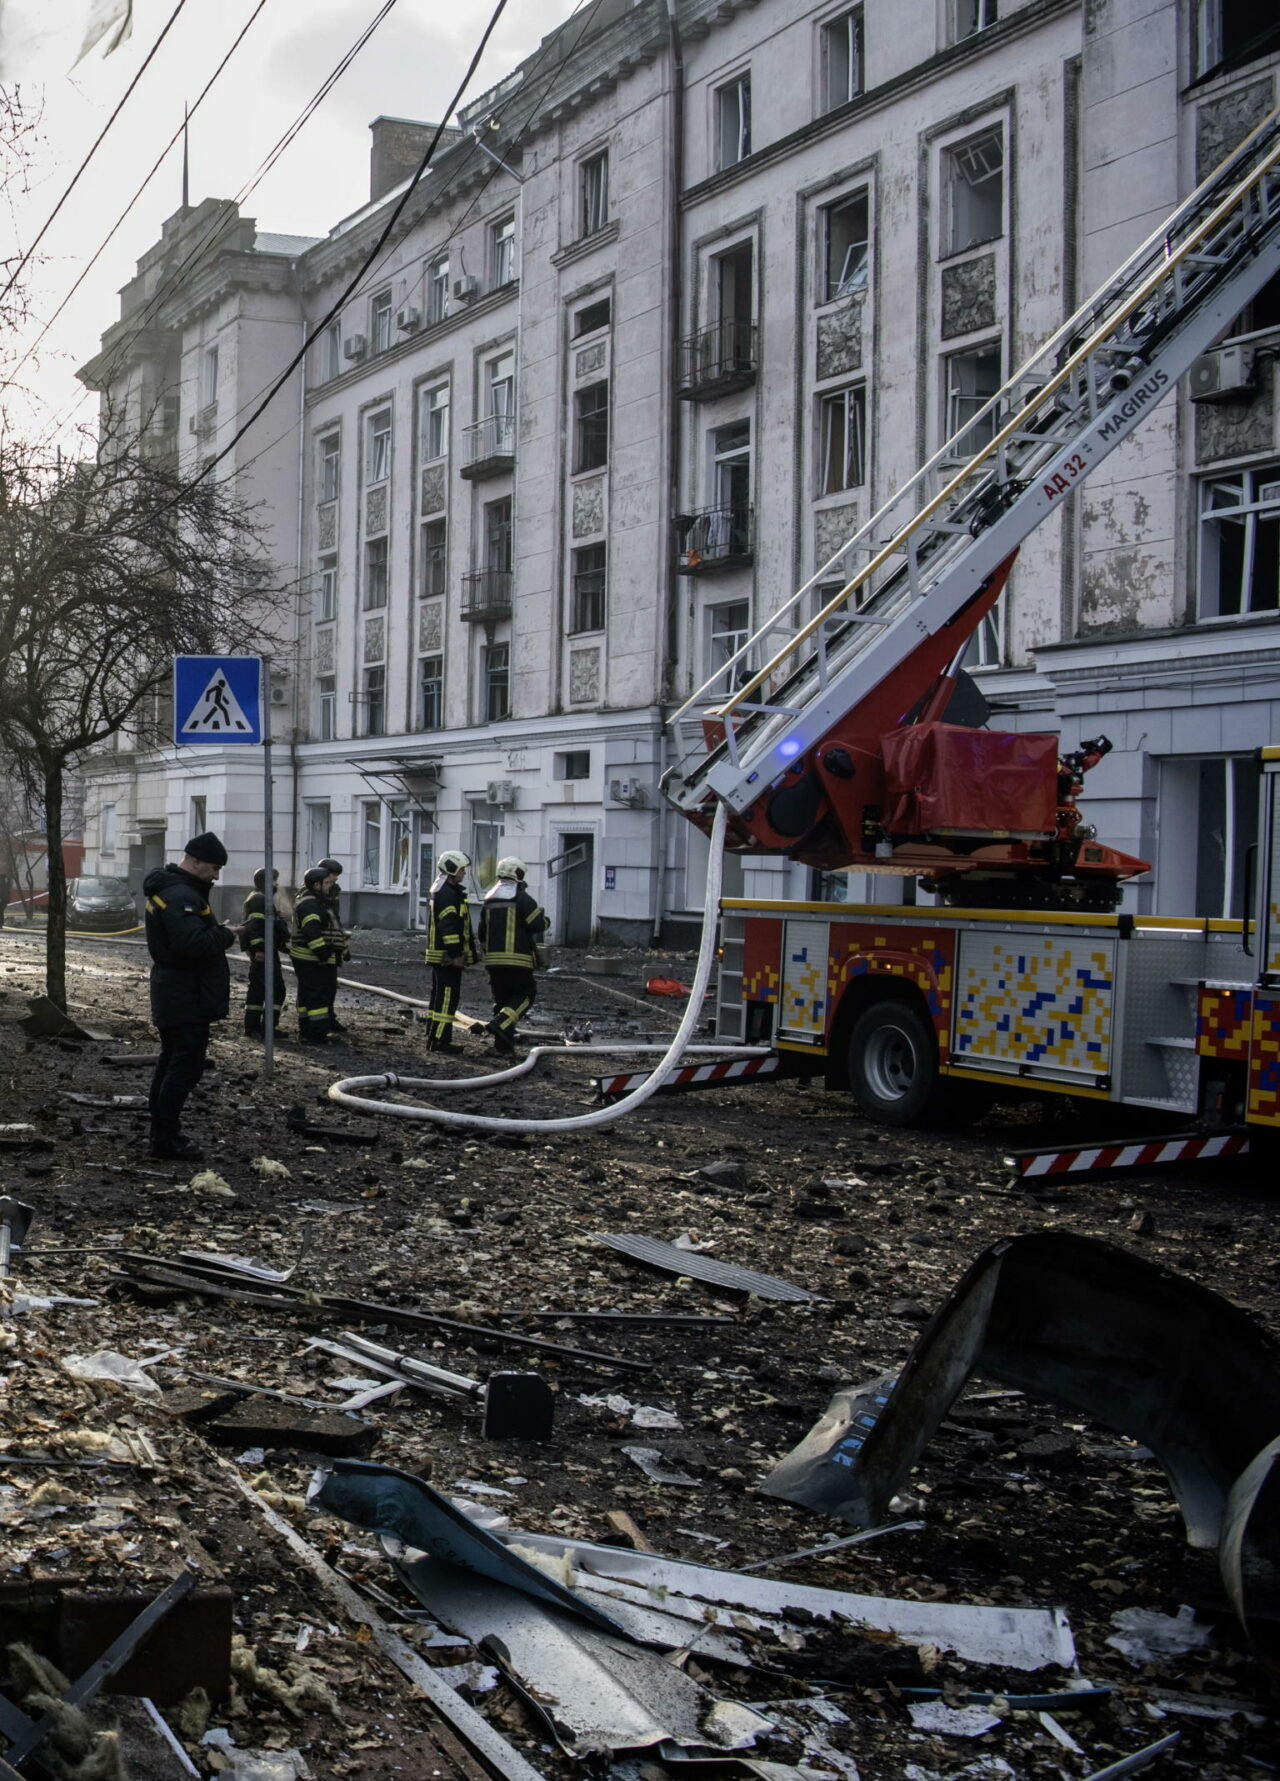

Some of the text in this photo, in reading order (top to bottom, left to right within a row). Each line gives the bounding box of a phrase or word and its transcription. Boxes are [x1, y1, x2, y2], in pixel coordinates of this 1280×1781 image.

[1097, 369, 1169, 441] MAGIRUS
[1042, 454, 1087, 500] АД 32
